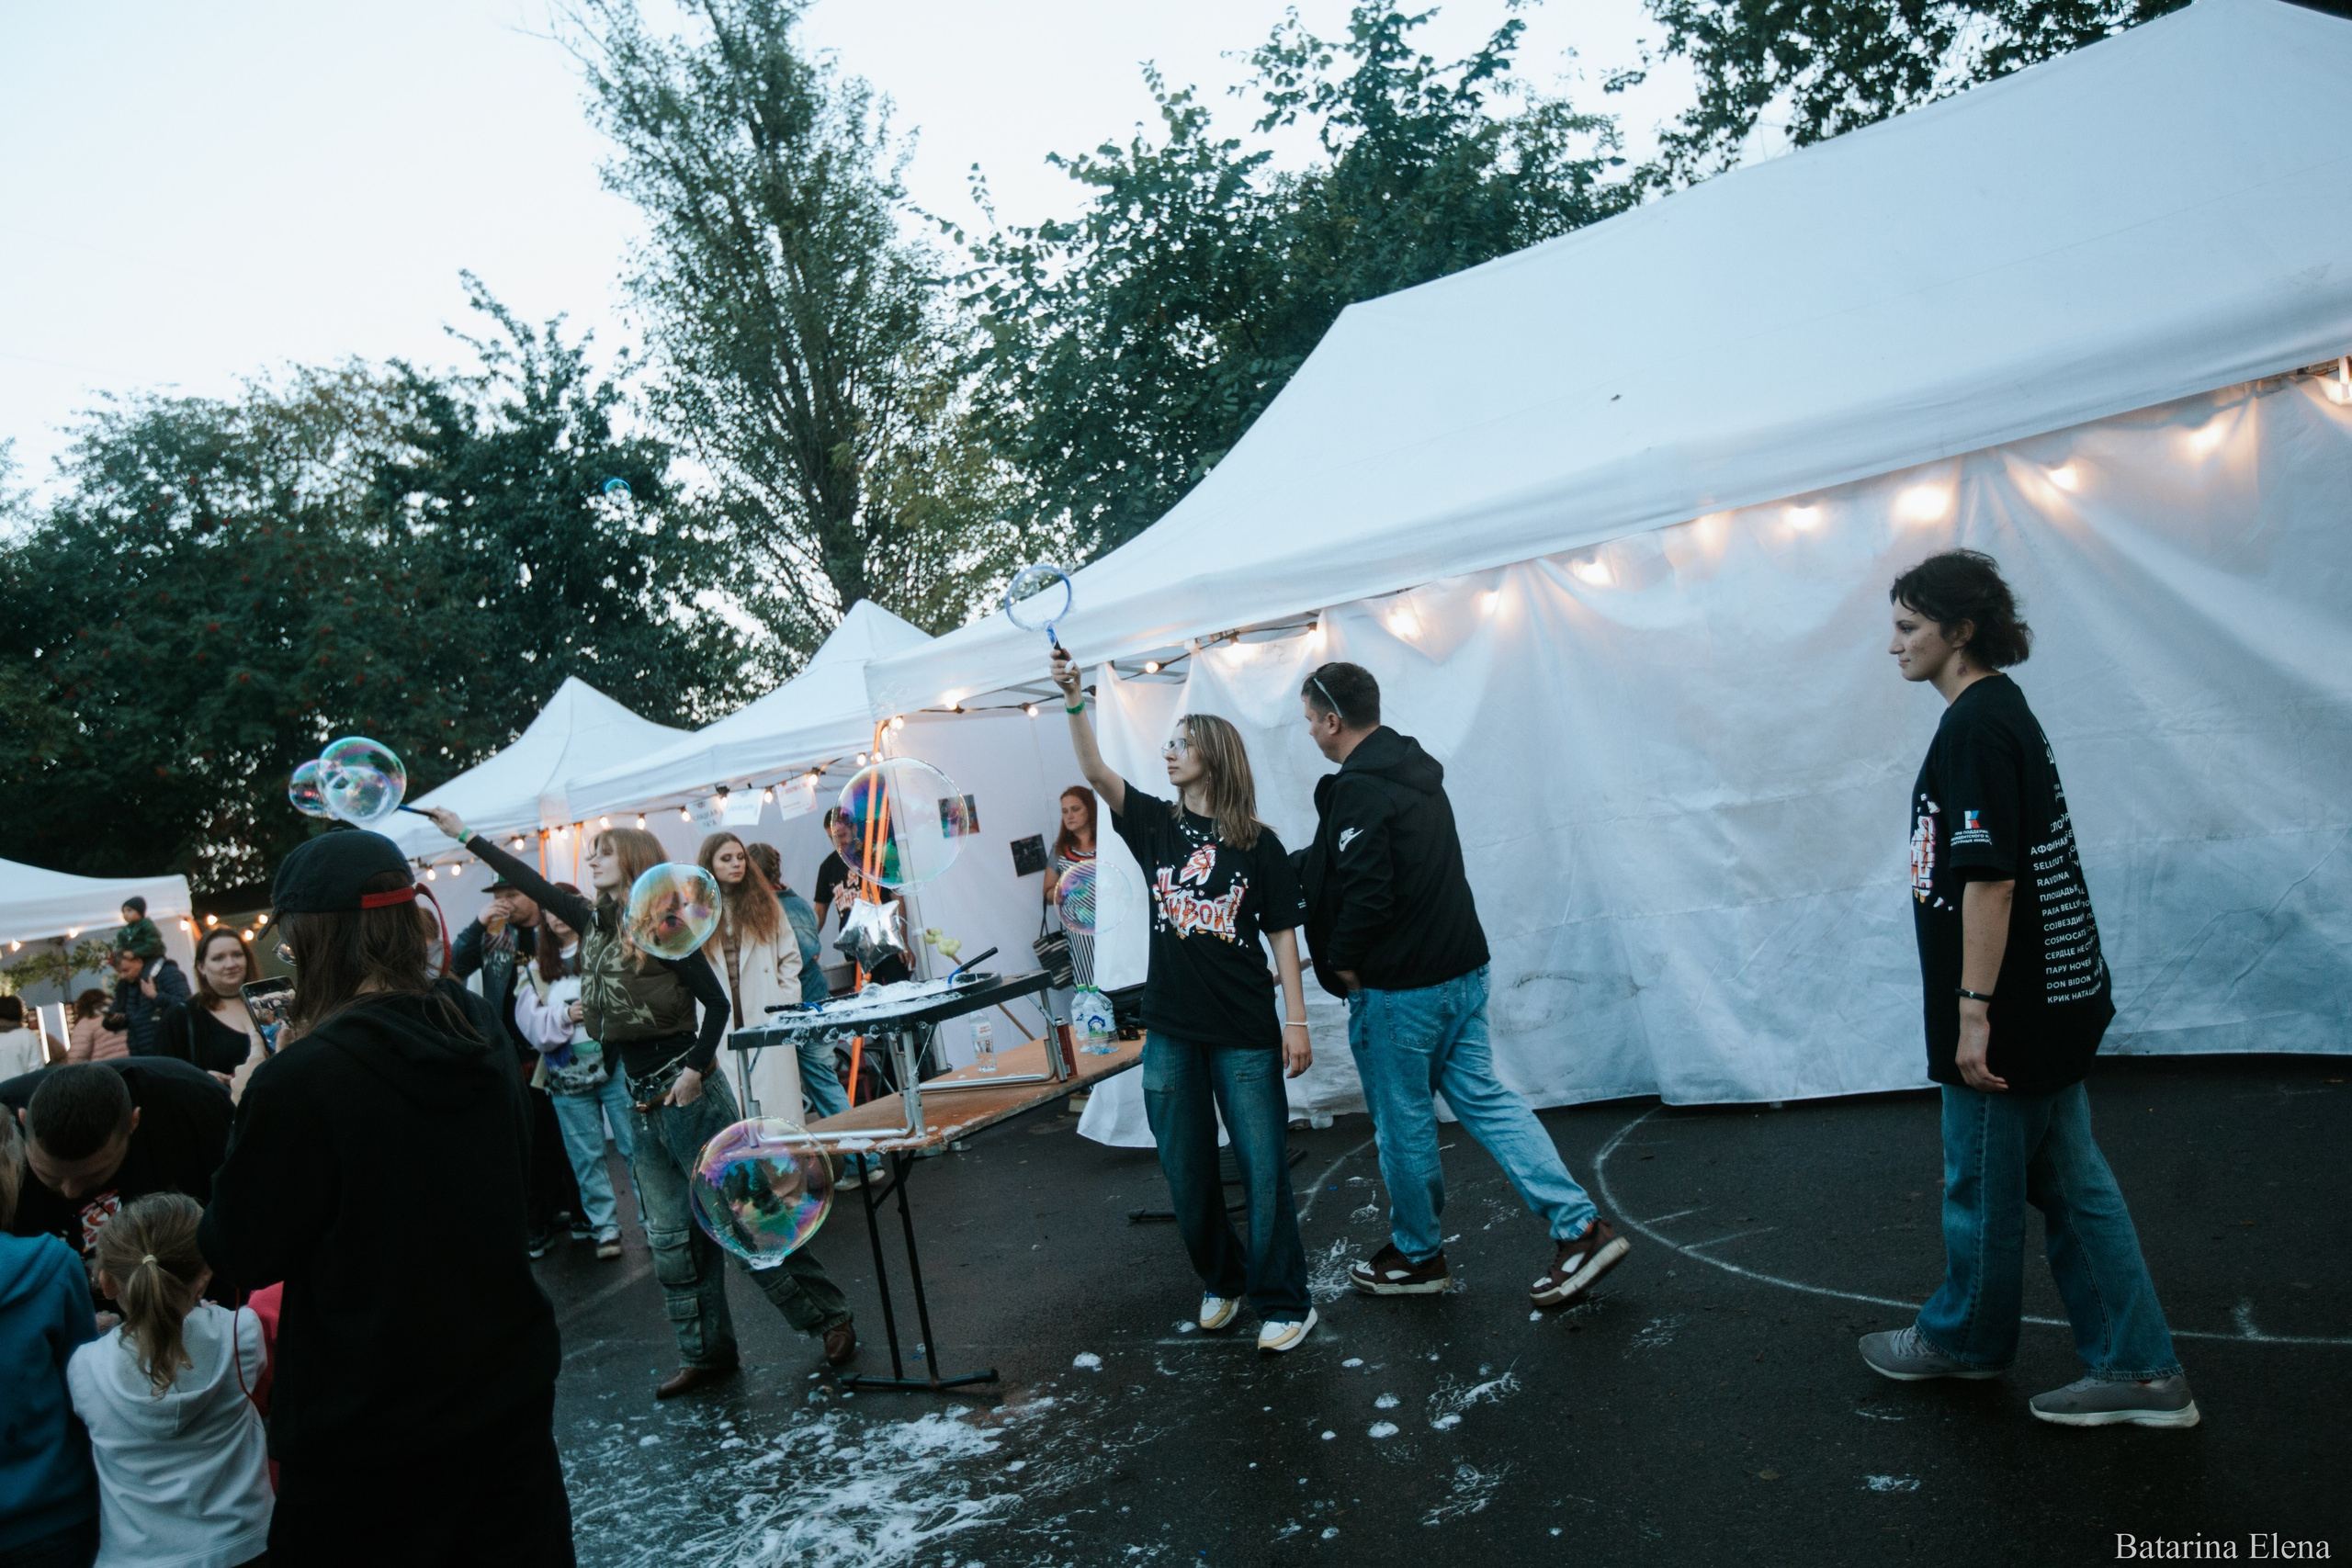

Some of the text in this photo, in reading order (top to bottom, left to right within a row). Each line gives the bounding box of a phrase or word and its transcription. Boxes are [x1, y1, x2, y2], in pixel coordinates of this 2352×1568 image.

[2033, 855, 2064, 871] SELLOUT
[2040, 886, 2075, 902] ПЛОЩАДЬ
[2044, 928, 2086, 946] COSMOCATS
[2044, 947, 2075, 960] СЕРДЦЕ
[2045, 964, 2067, 975] ПАРУ
[2046, 975, 2092, 990] DON BIDON
[2047, 994, 2070, 1004] КРИК
